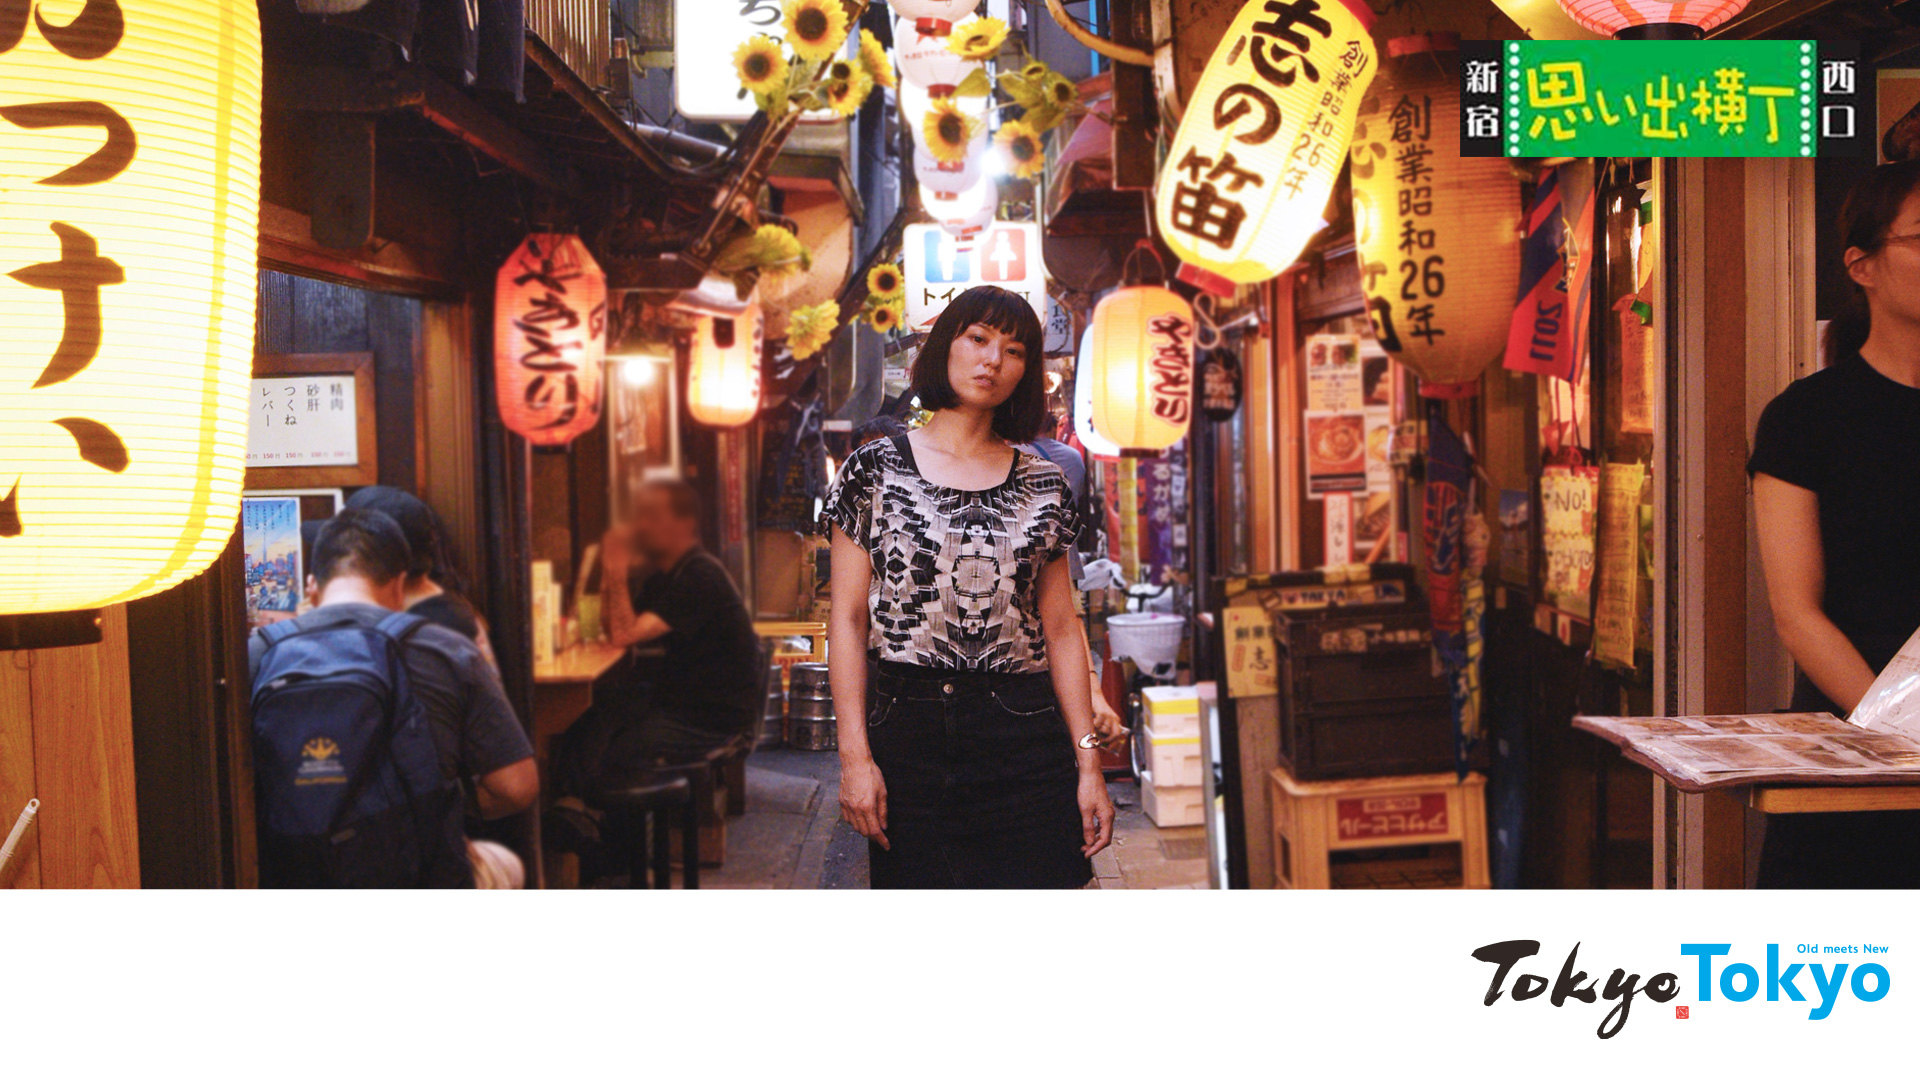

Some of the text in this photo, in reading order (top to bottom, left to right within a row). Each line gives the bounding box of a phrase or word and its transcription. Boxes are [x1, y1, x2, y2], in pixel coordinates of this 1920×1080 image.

[1171, 0, 1333, 250] 志の笛
[1283, 40, 1369, 200] 創業昭和26年
[1388, 94, 1445, 346] 創業昭和26年
[923, 287, 967, 307] トイ
[1149, 313, 1192, 425] やきとり
[262, 387, 274, 427] レバー
[284, 386, 297, 426] つくね
[306, 384, 321, 412] 砂肝
[1555, 488, 1587, 512] NO!
[1340, 811, 1447, 836] アサヒビール
